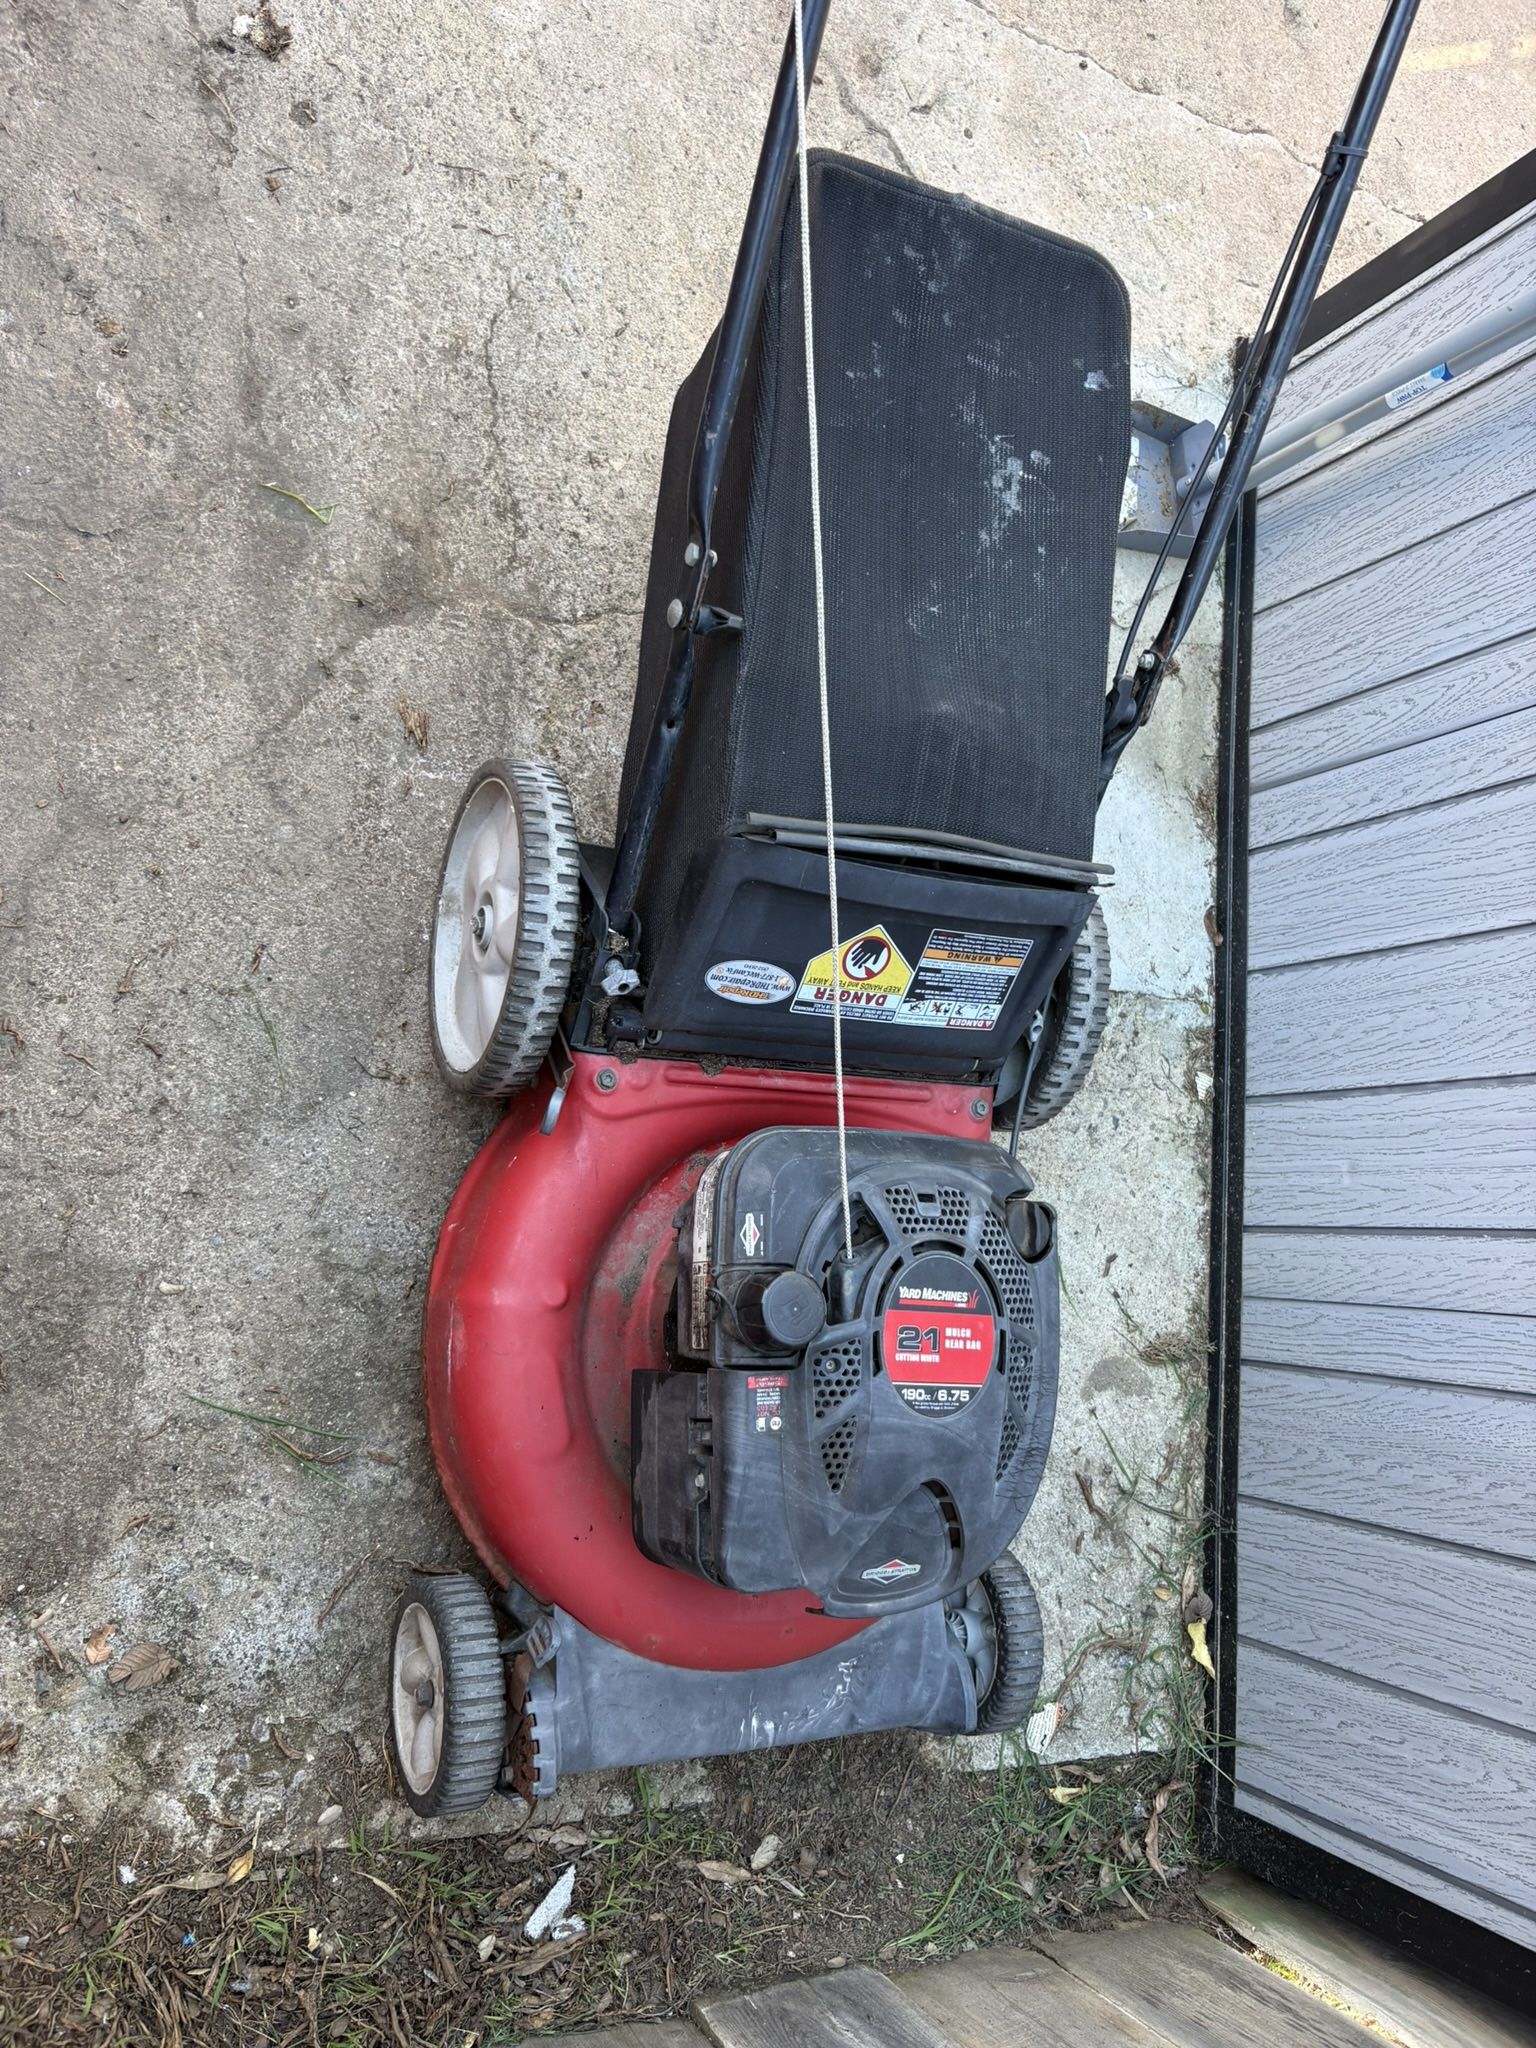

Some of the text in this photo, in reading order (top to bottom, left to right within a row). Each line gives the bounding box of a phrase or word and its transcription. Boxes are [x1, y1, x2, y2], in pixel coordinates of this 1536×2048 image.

[946, 952, 992, 964] WARNING
[807, 976, 830, 986] AWAY
[859, 982, 883, 992] HANDS
[884, 985, 902, 994] KEEP
[814, 987, 888, 1007] DANGER
[949, 1018, 984, 1028] DANGER
[899, 1286, 968, 1302] YARD MACHINES
[945, 1327, 972, 1338] MULCH
[896, 1324, 940, 1353] 21
[945, 1340, 982, 1351] REAR BAG
[895, 1353, 940, 1363] CUTTING WIDTH
[937, 1389, 970, 1402] 6.75
